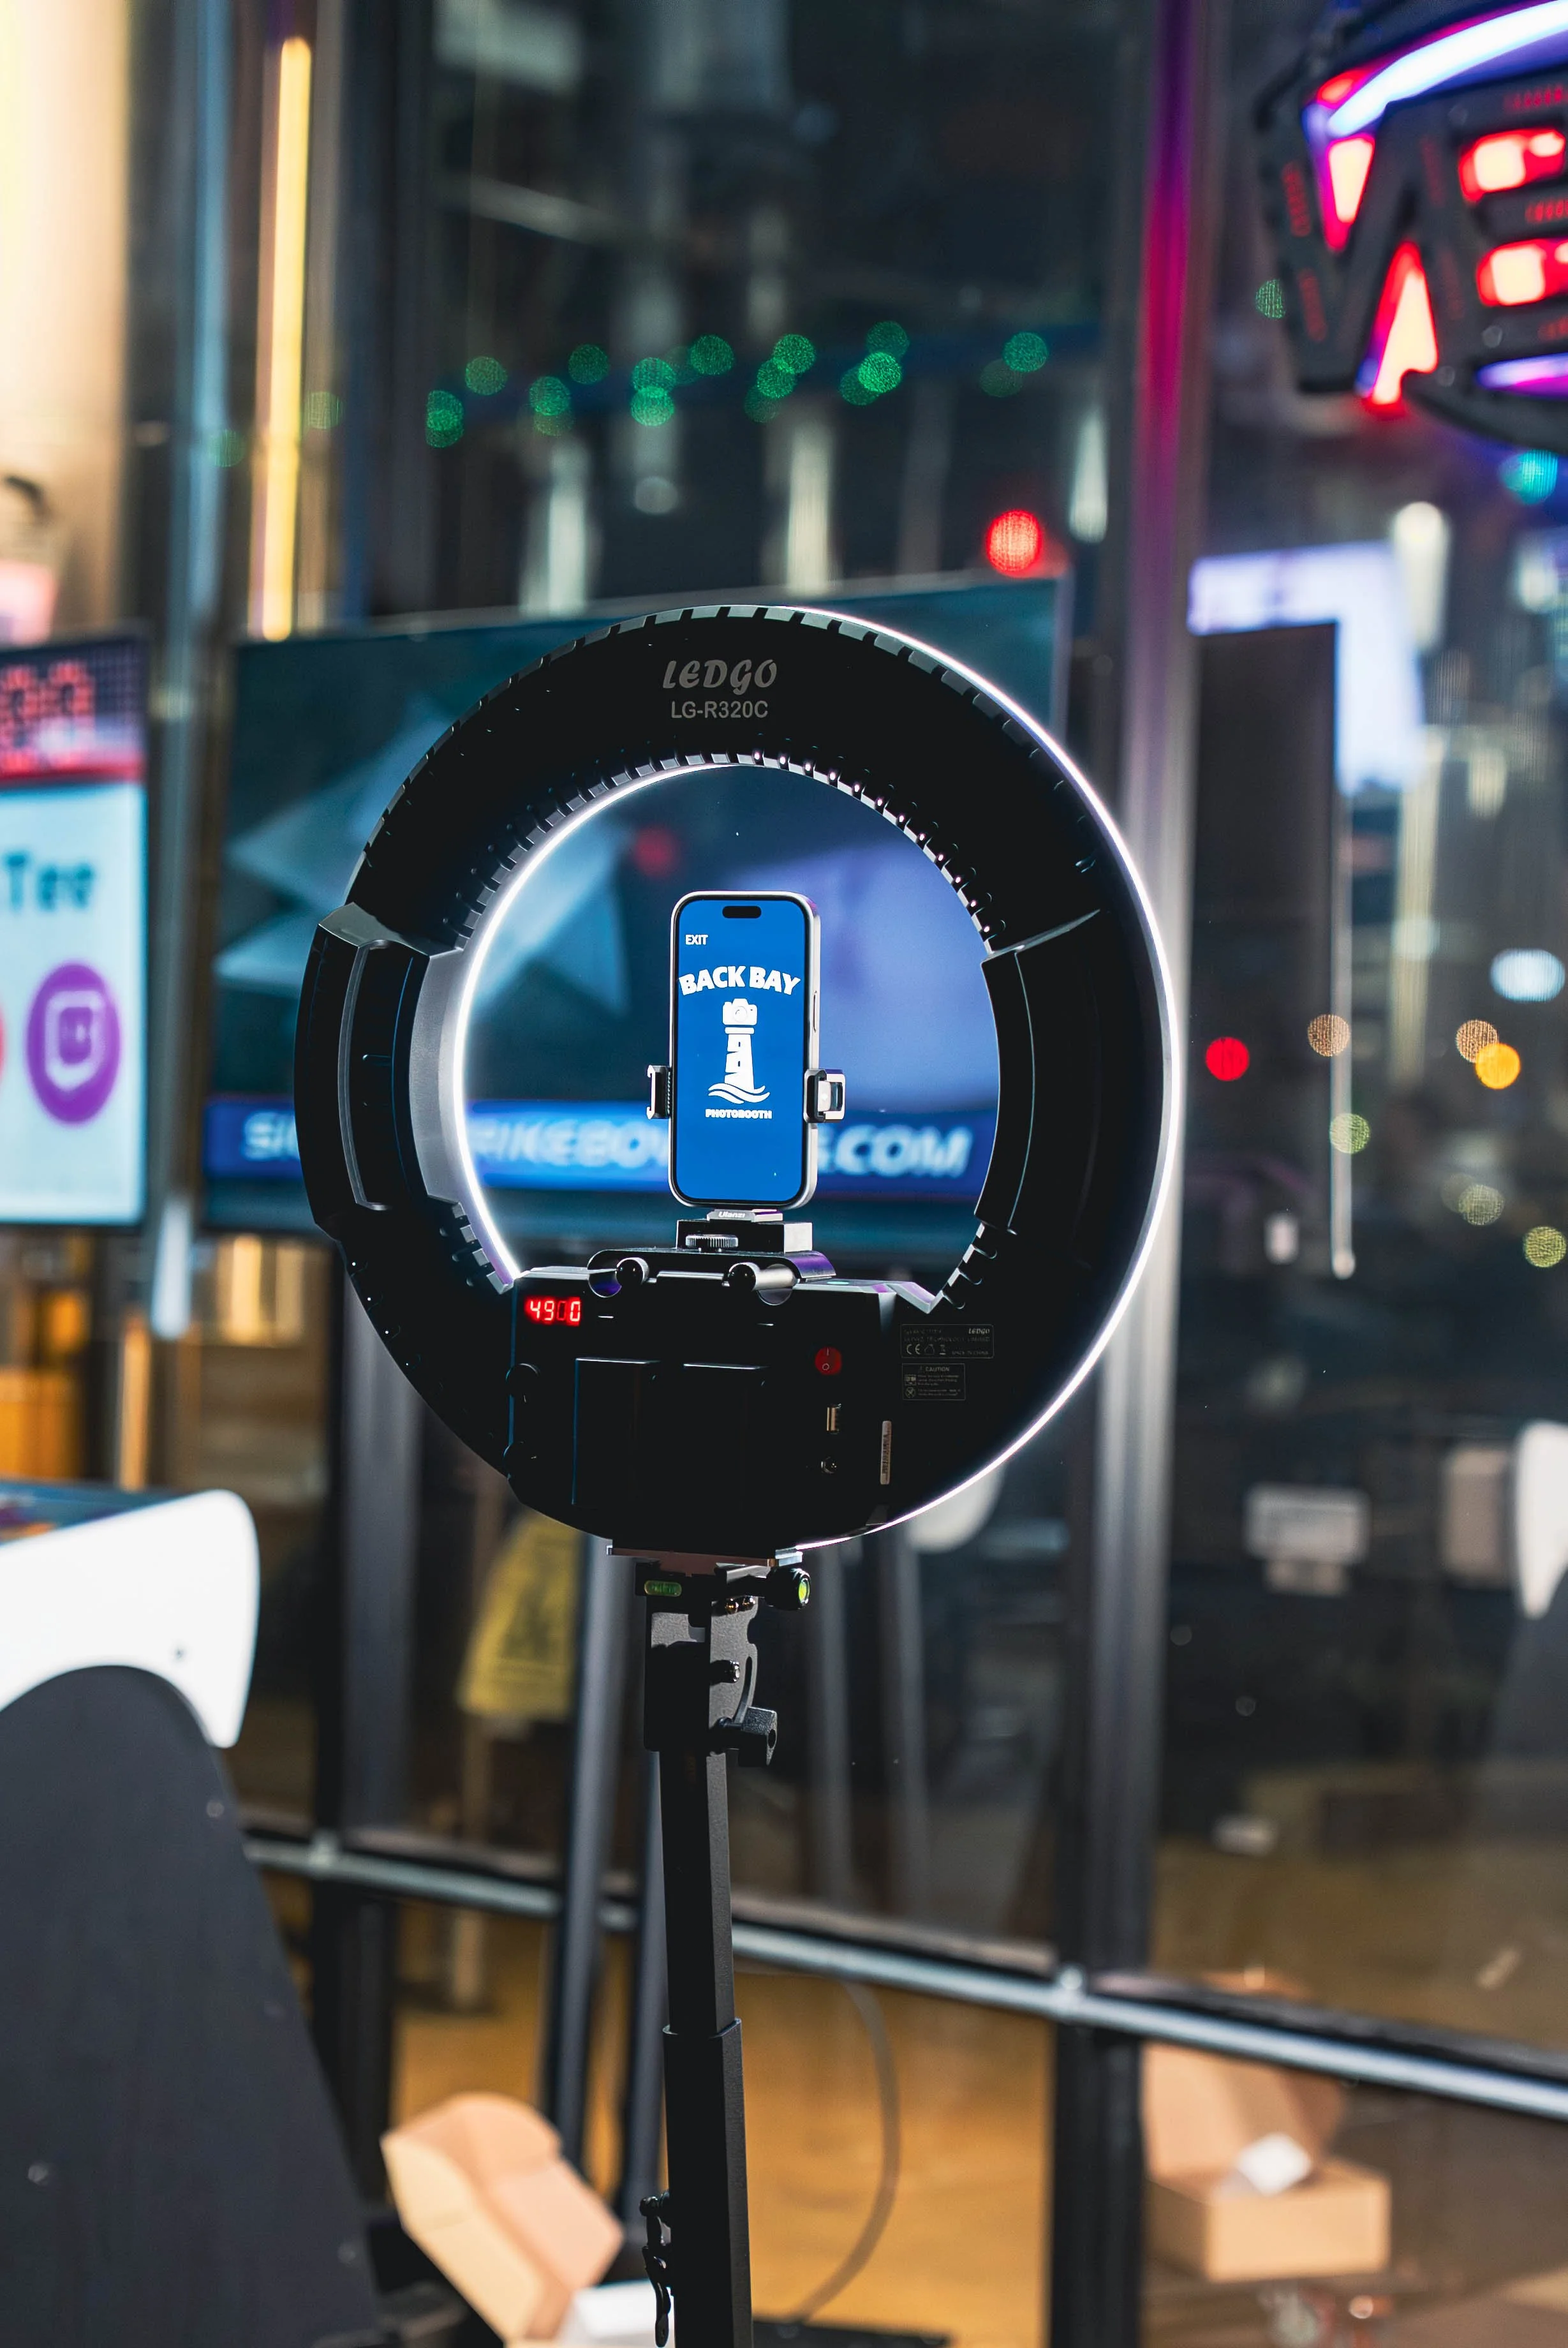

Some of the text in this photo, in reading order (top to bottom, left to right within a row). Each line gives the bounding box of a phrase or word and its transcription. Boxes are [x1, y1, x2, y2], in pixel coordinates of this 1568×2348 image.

[662, 659, 777, 695] LEDGO
[671, 701, 768, 718] LG-R320C
[685, 934, 709, 945] EXIT
[678, 965, 801, 996] BACK BAY
[705, 1108, 773, 1119] PHOTOBOOTH
